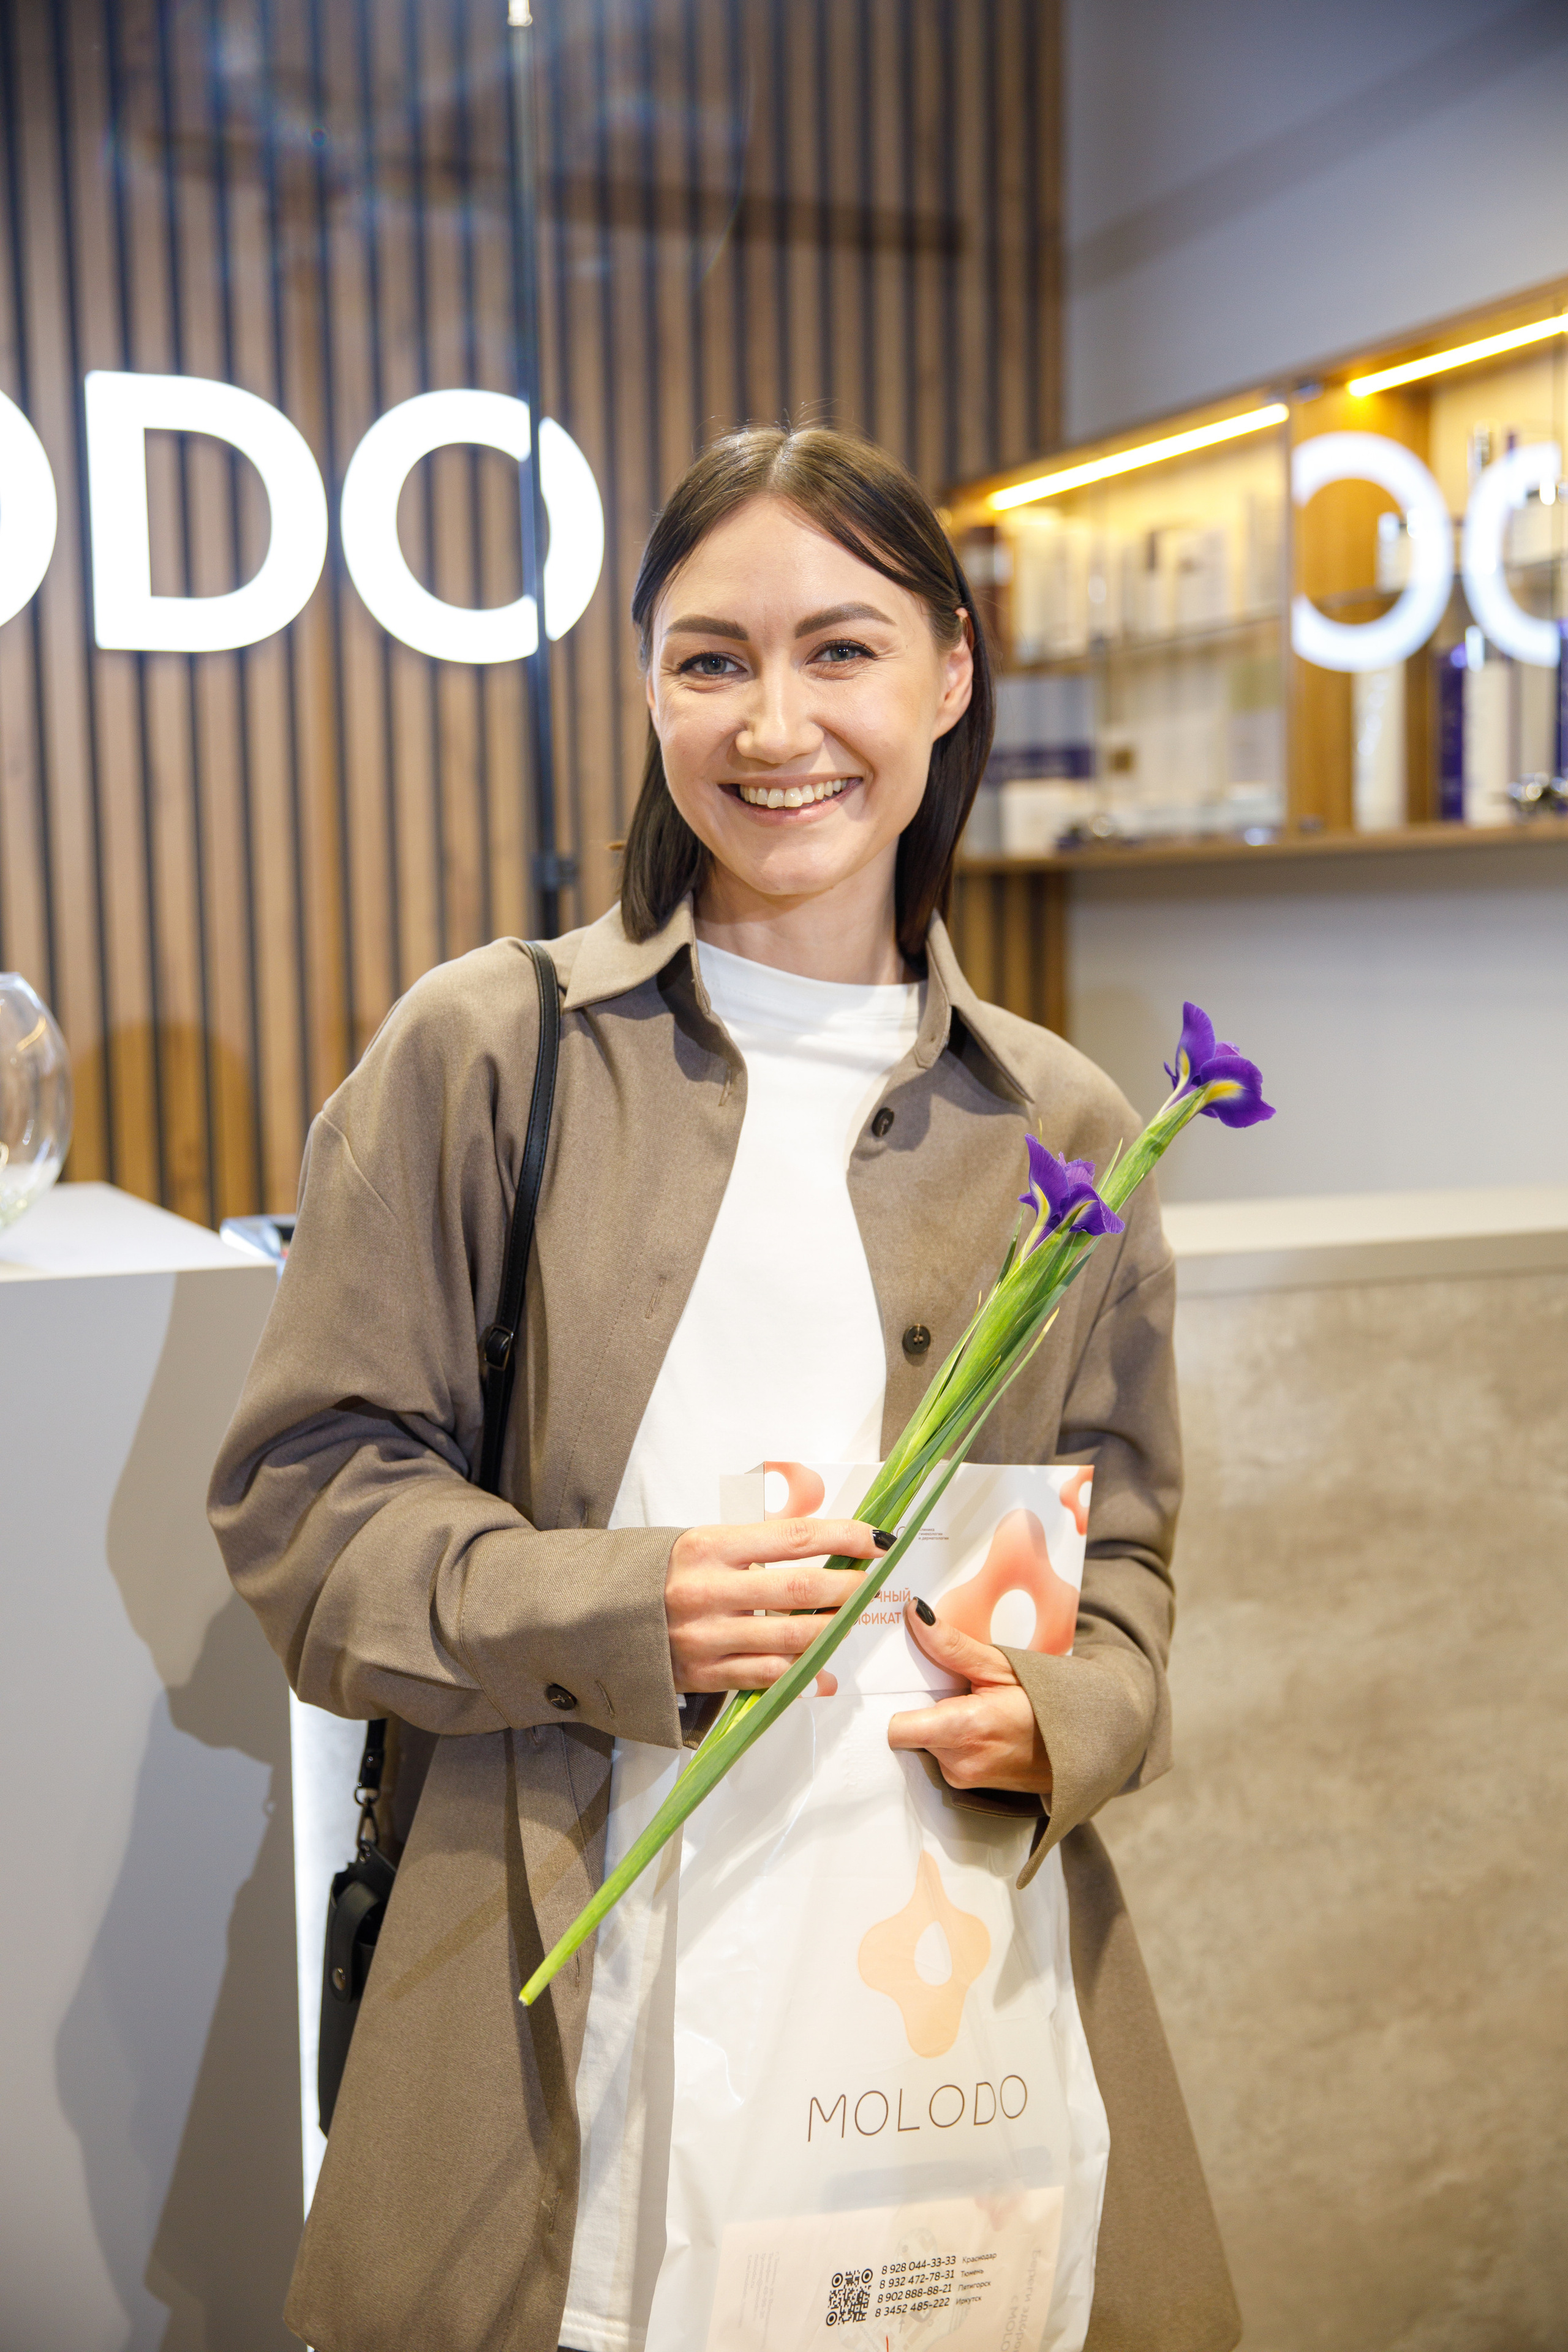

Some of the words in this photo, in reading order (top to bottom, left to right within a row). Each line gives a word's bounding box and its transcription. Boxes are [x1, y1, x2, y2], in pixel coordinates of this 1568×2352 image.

[0, 370, 605, 665] DO
[807, 2075, 1028, 2143] MOLODO
[879, 2279, 886, 2289] 8
[888, 2276, 906, 2288] 932
[908, 2269, 955, 2285] 472-78-31
[960, 2269, 984, 2278] Тюмень
[881, 2266, 888, 2275] 8
[889, 2262, 907, 2274] 928
[908, 2255, 957, 2271] 044-33-33
[962, 2253, 997, 2264] Краснодар
[1024, 2249, 1041, 2302] Береги
[875, 2308, 881, 2318] 8
[883, 2304, 908, 2316] 3452
[910, 2297, 950, 2312] 485-222
[956, 2296, 982, 2305] Иркутск
[877, 2294, 883, 2304] 8
[885, 2291, 903, 2302] 902
[905, 2283, 952, 2299] 888-88-21
[957, 2280, 992, 2292] Пятигорск
[1013, 2305, 1030, 2352] здоро
